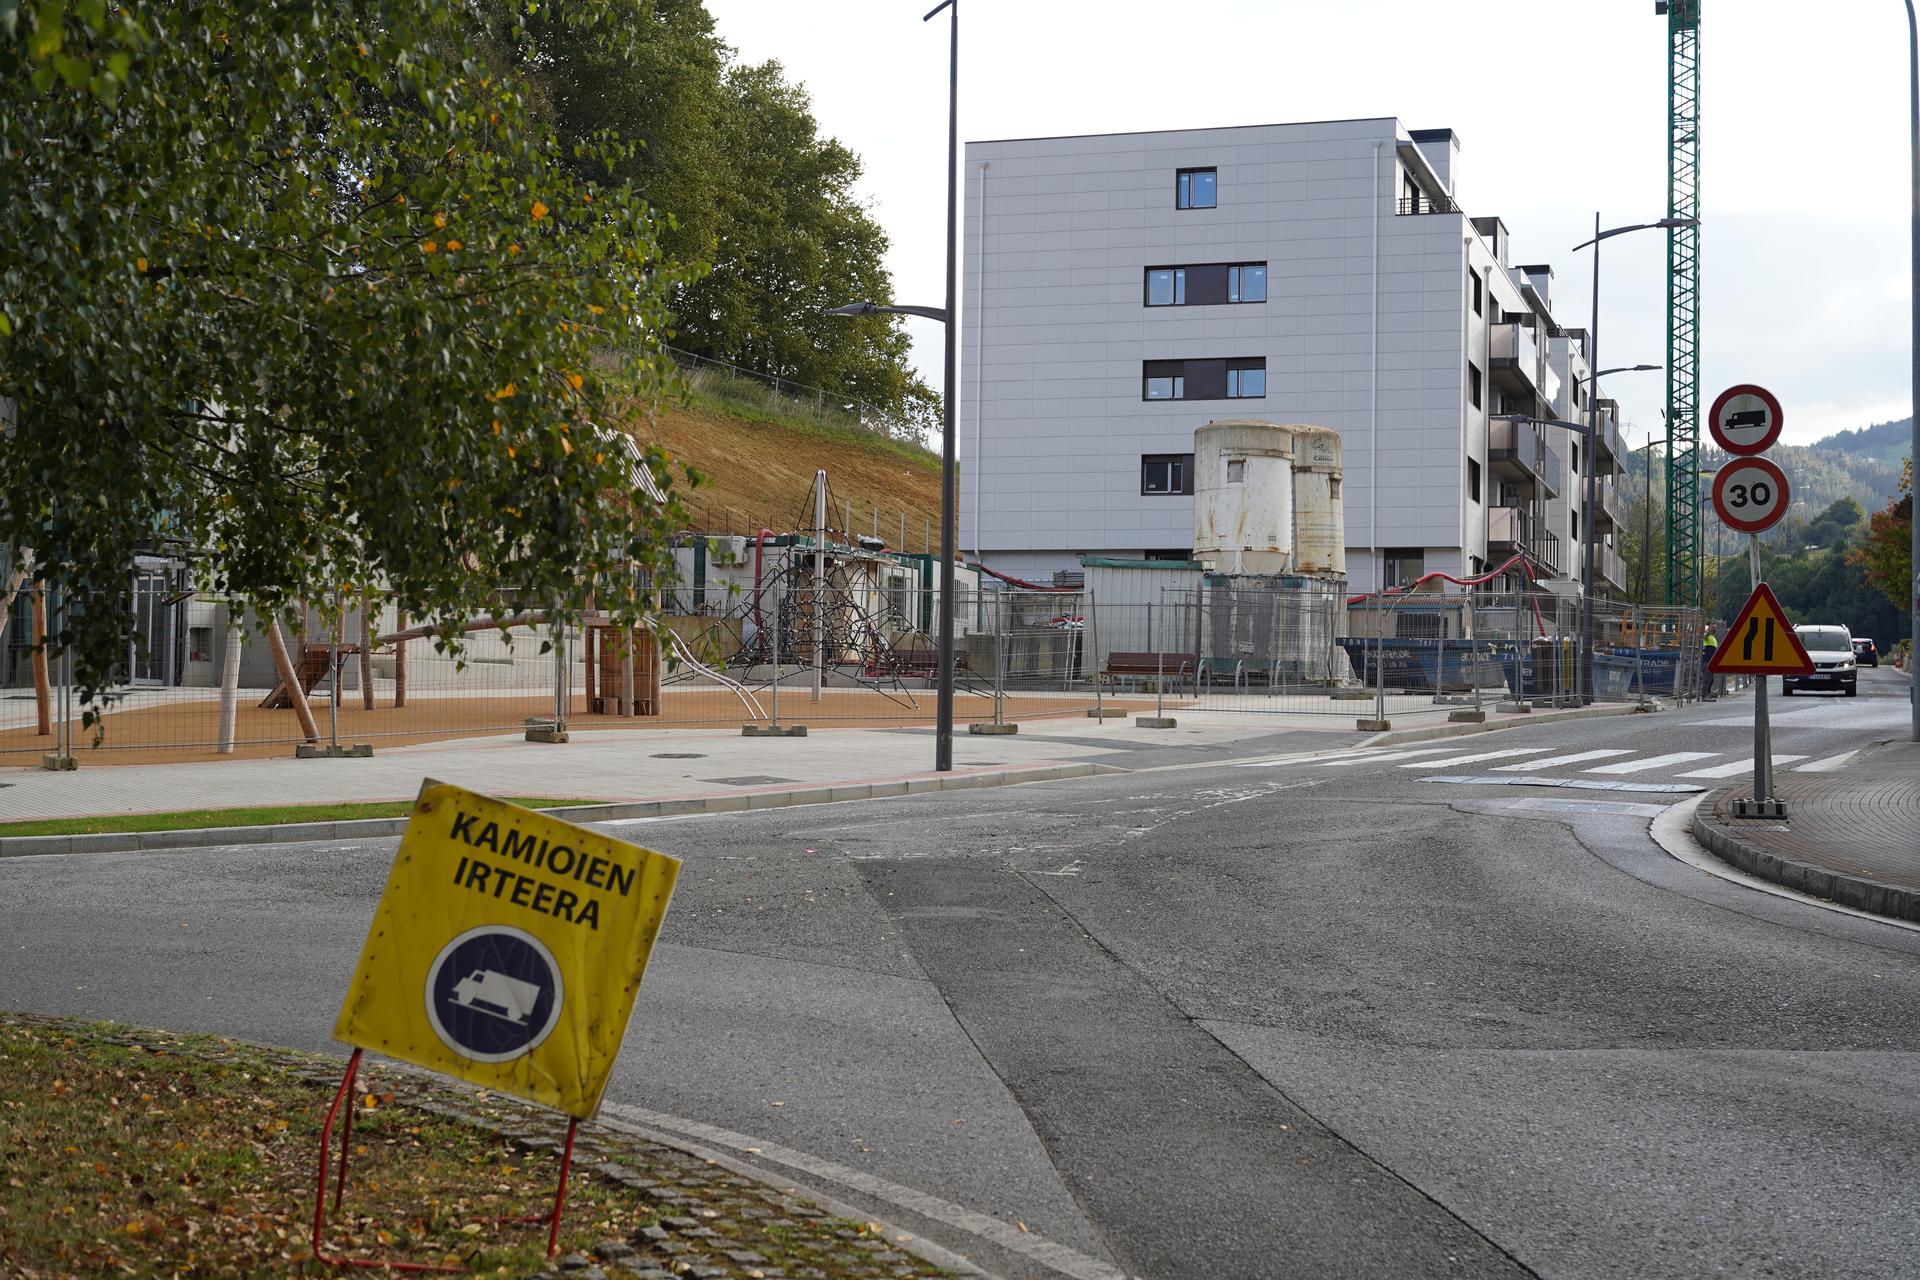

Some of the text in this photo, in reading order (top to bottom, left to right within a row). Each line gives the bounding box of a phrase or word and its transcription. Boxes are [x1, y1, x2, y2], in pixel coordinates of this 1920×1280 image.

[1729, 482, 1771, 508] 30
[450, 811, 636, 897] KAMIOIEN
[453, 856, 600, 931] IRTEERA
